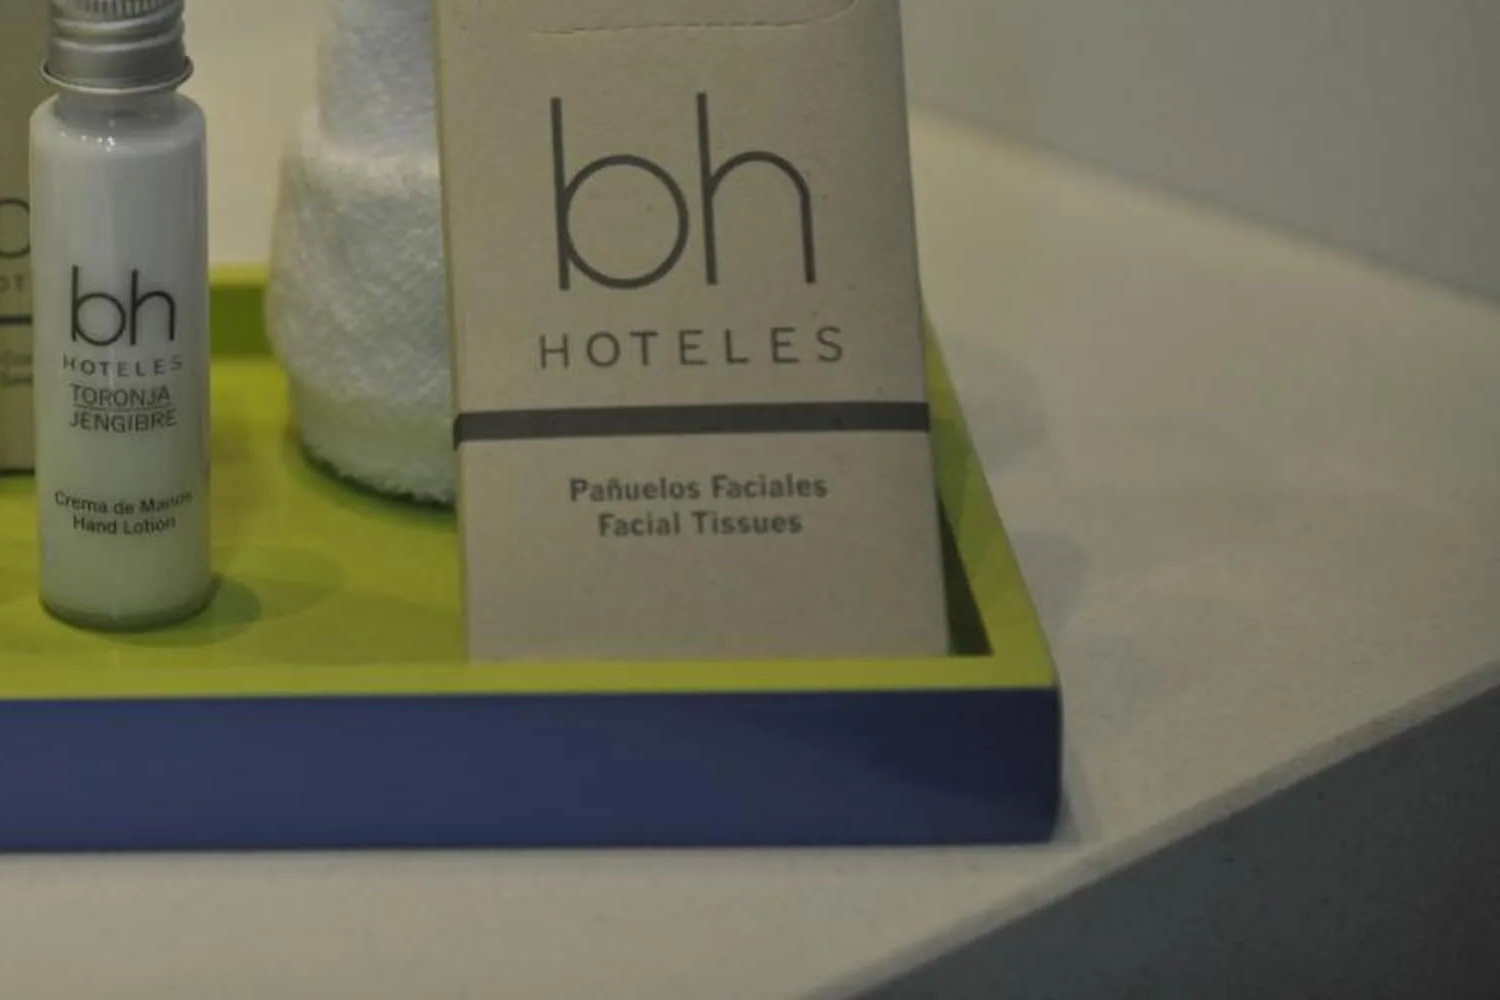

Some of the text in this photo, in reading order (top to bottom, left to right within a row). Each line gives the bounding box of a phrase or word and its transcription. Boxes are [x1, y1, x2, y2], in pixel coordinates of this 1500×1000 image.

[551, 92, 816, 290] bh
[71, 265, 176, 346] bh
[539, 326, 844, 370] HOTELES
[62, 353, 184, 378] HOTELES
[68, 384, 172, 409] TORONJA
[67, 408, 178, 433] JENGIBRE
[569, 472, 829, 502] Pañuelos Faciales
[53, 490, 195, 515] Crema de Manos
[72, 514, 177, 535] Hand Lotion
[598, 509, 805, 537] Facial Tissues
